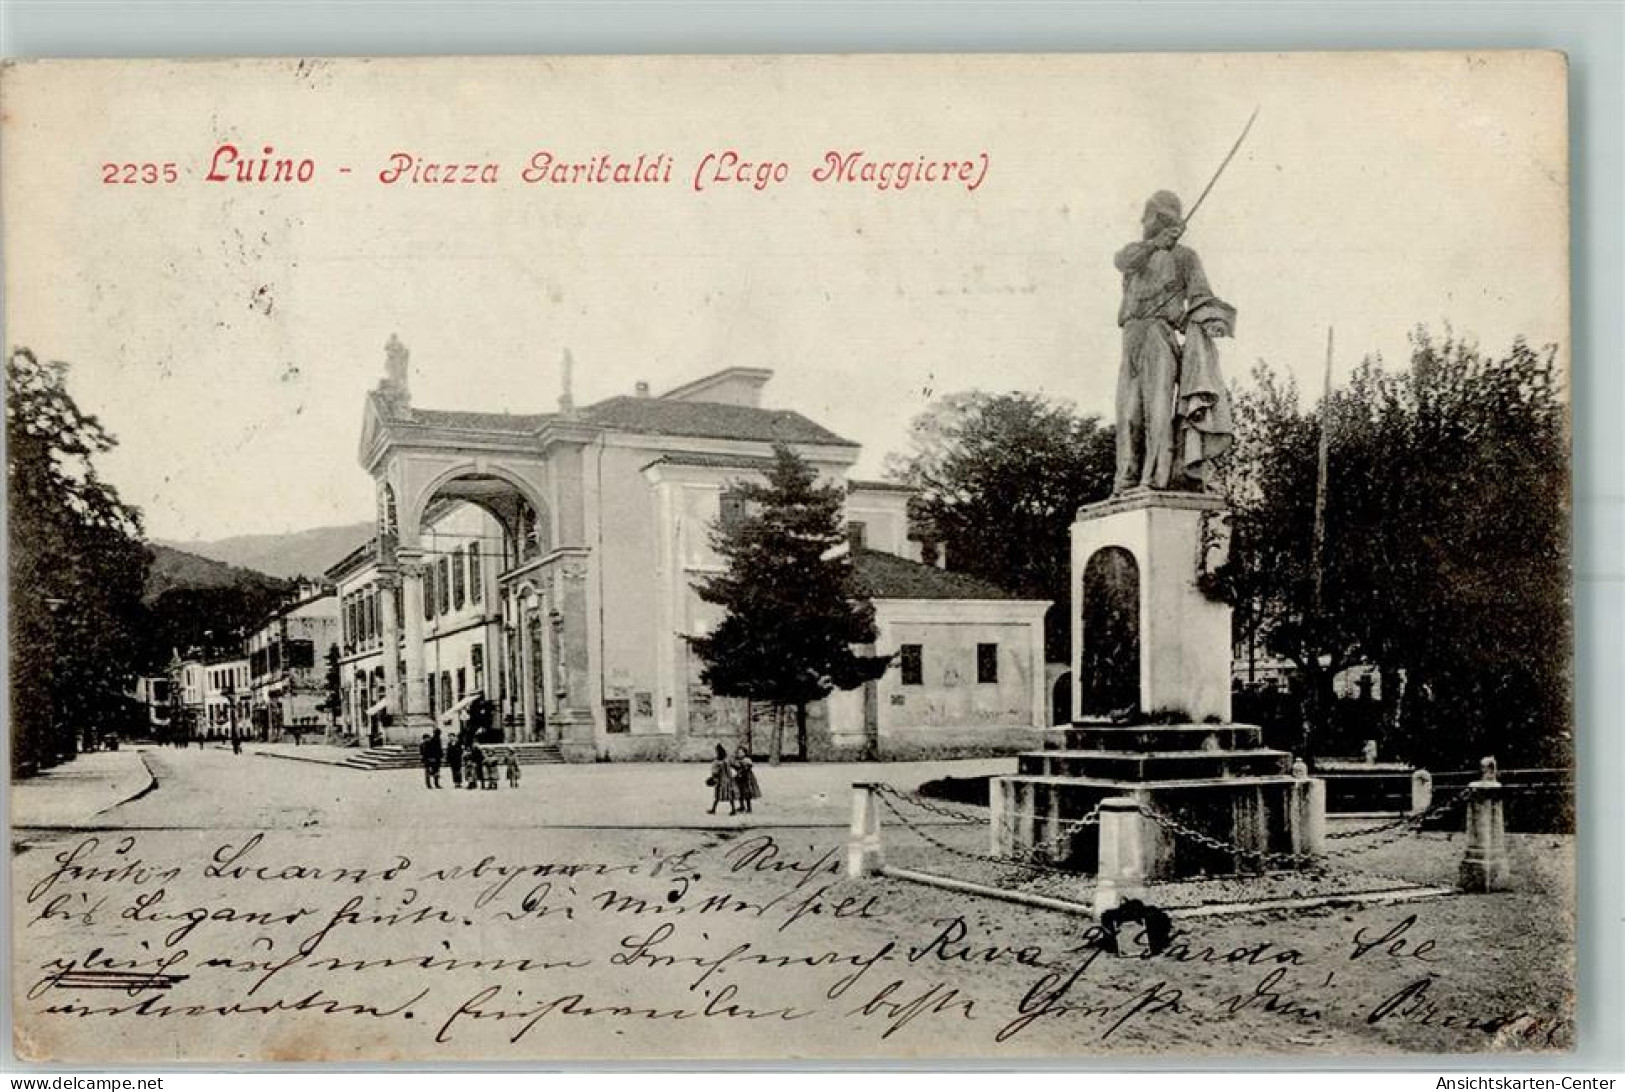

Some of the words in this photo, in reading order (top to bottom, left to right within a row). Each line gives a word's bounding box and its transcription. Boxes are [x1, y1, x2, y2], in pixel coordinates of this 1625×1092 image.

[101, 163, 179, 185] 2235
[205, 144, 315, 183] Luino
[379, 152, 500, 185] Piazza
[521, 152, 674, 185] Garibaldi
[694, 151, 789, 191] (Lago
